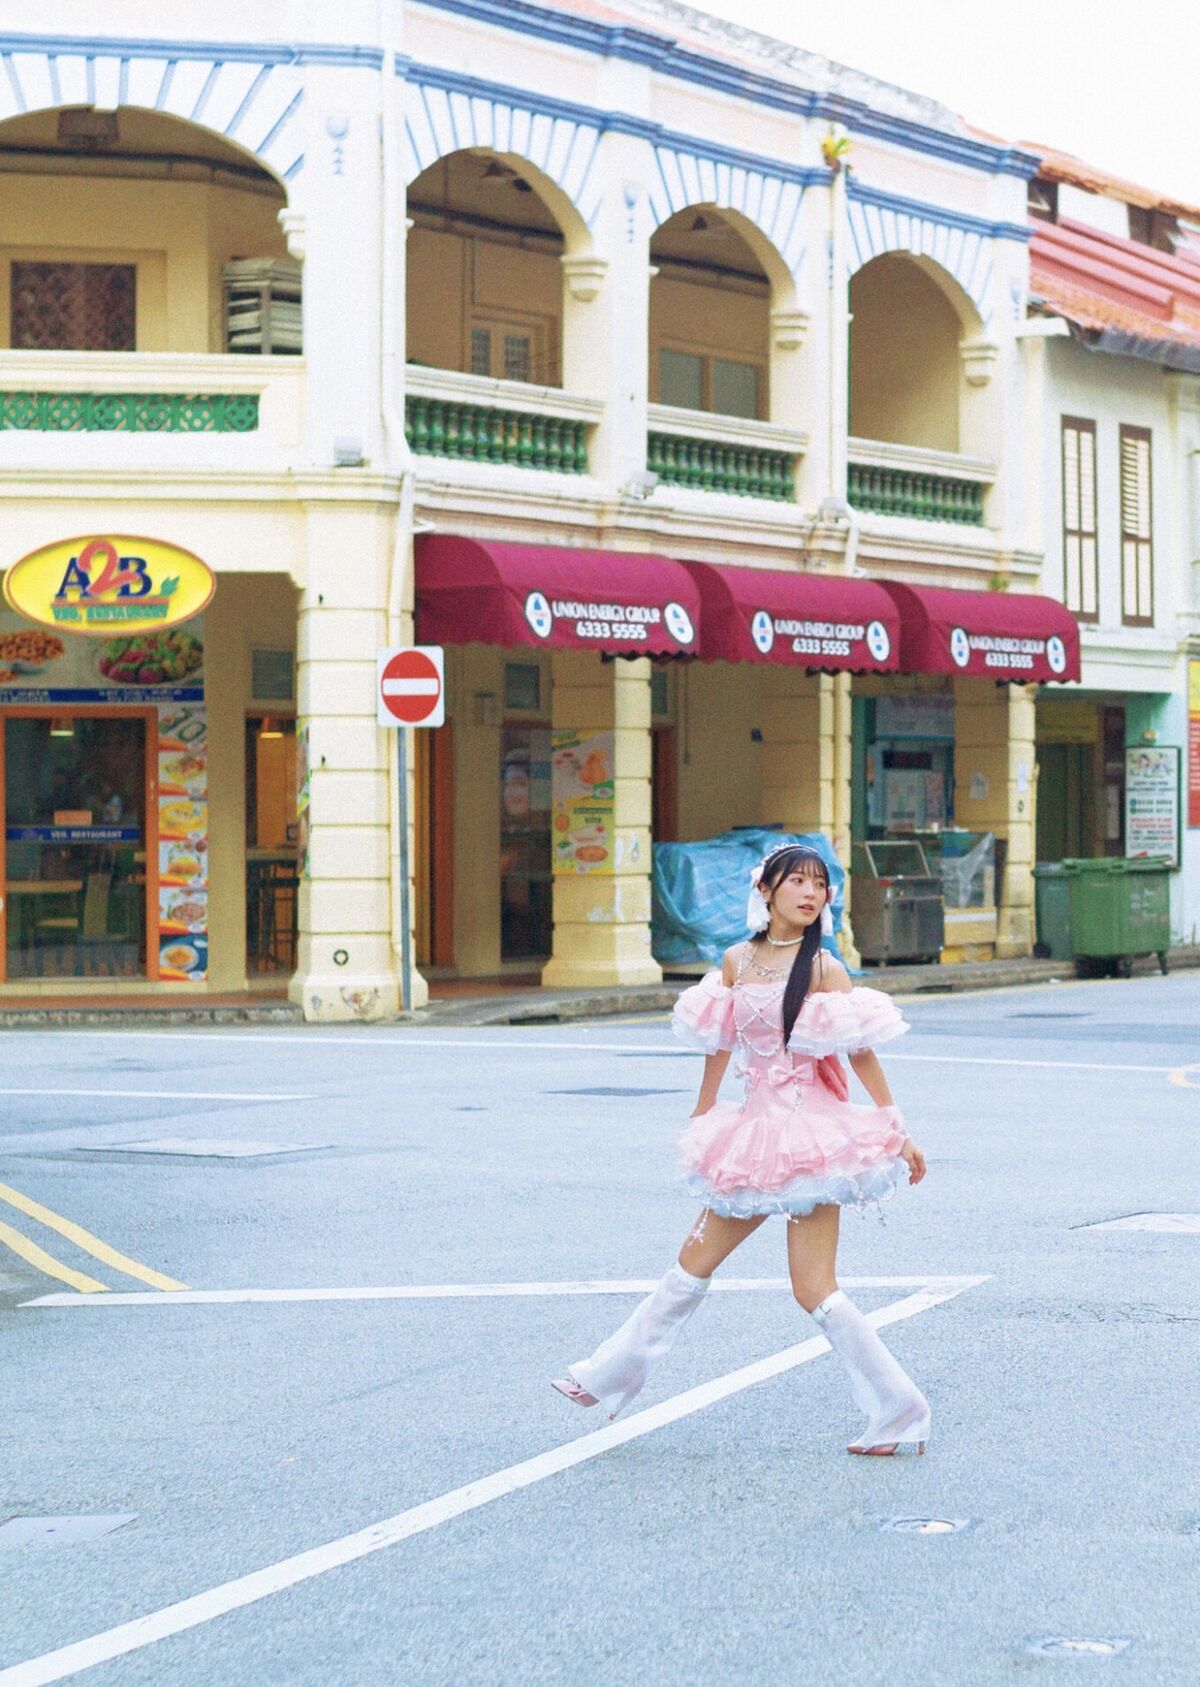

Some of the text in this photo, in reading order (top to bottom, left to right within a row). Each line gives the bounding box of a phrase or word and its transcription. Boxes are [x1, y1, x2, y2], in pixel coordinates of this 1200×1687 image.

[55, 540, 153, 598] A2B
[552, 601, 661, 622] UNION ENERGY GROUP
[576, 621, 648, 639] 6333 5555
[774, 620, 804, 635] UNION
[835, 625, 865, 639] GROUP
[792, 638, 851, 655] 6333 5555
[1009, 653, 1034, 669] 5555
[71, 829, 123, 839] RESTAURANT
